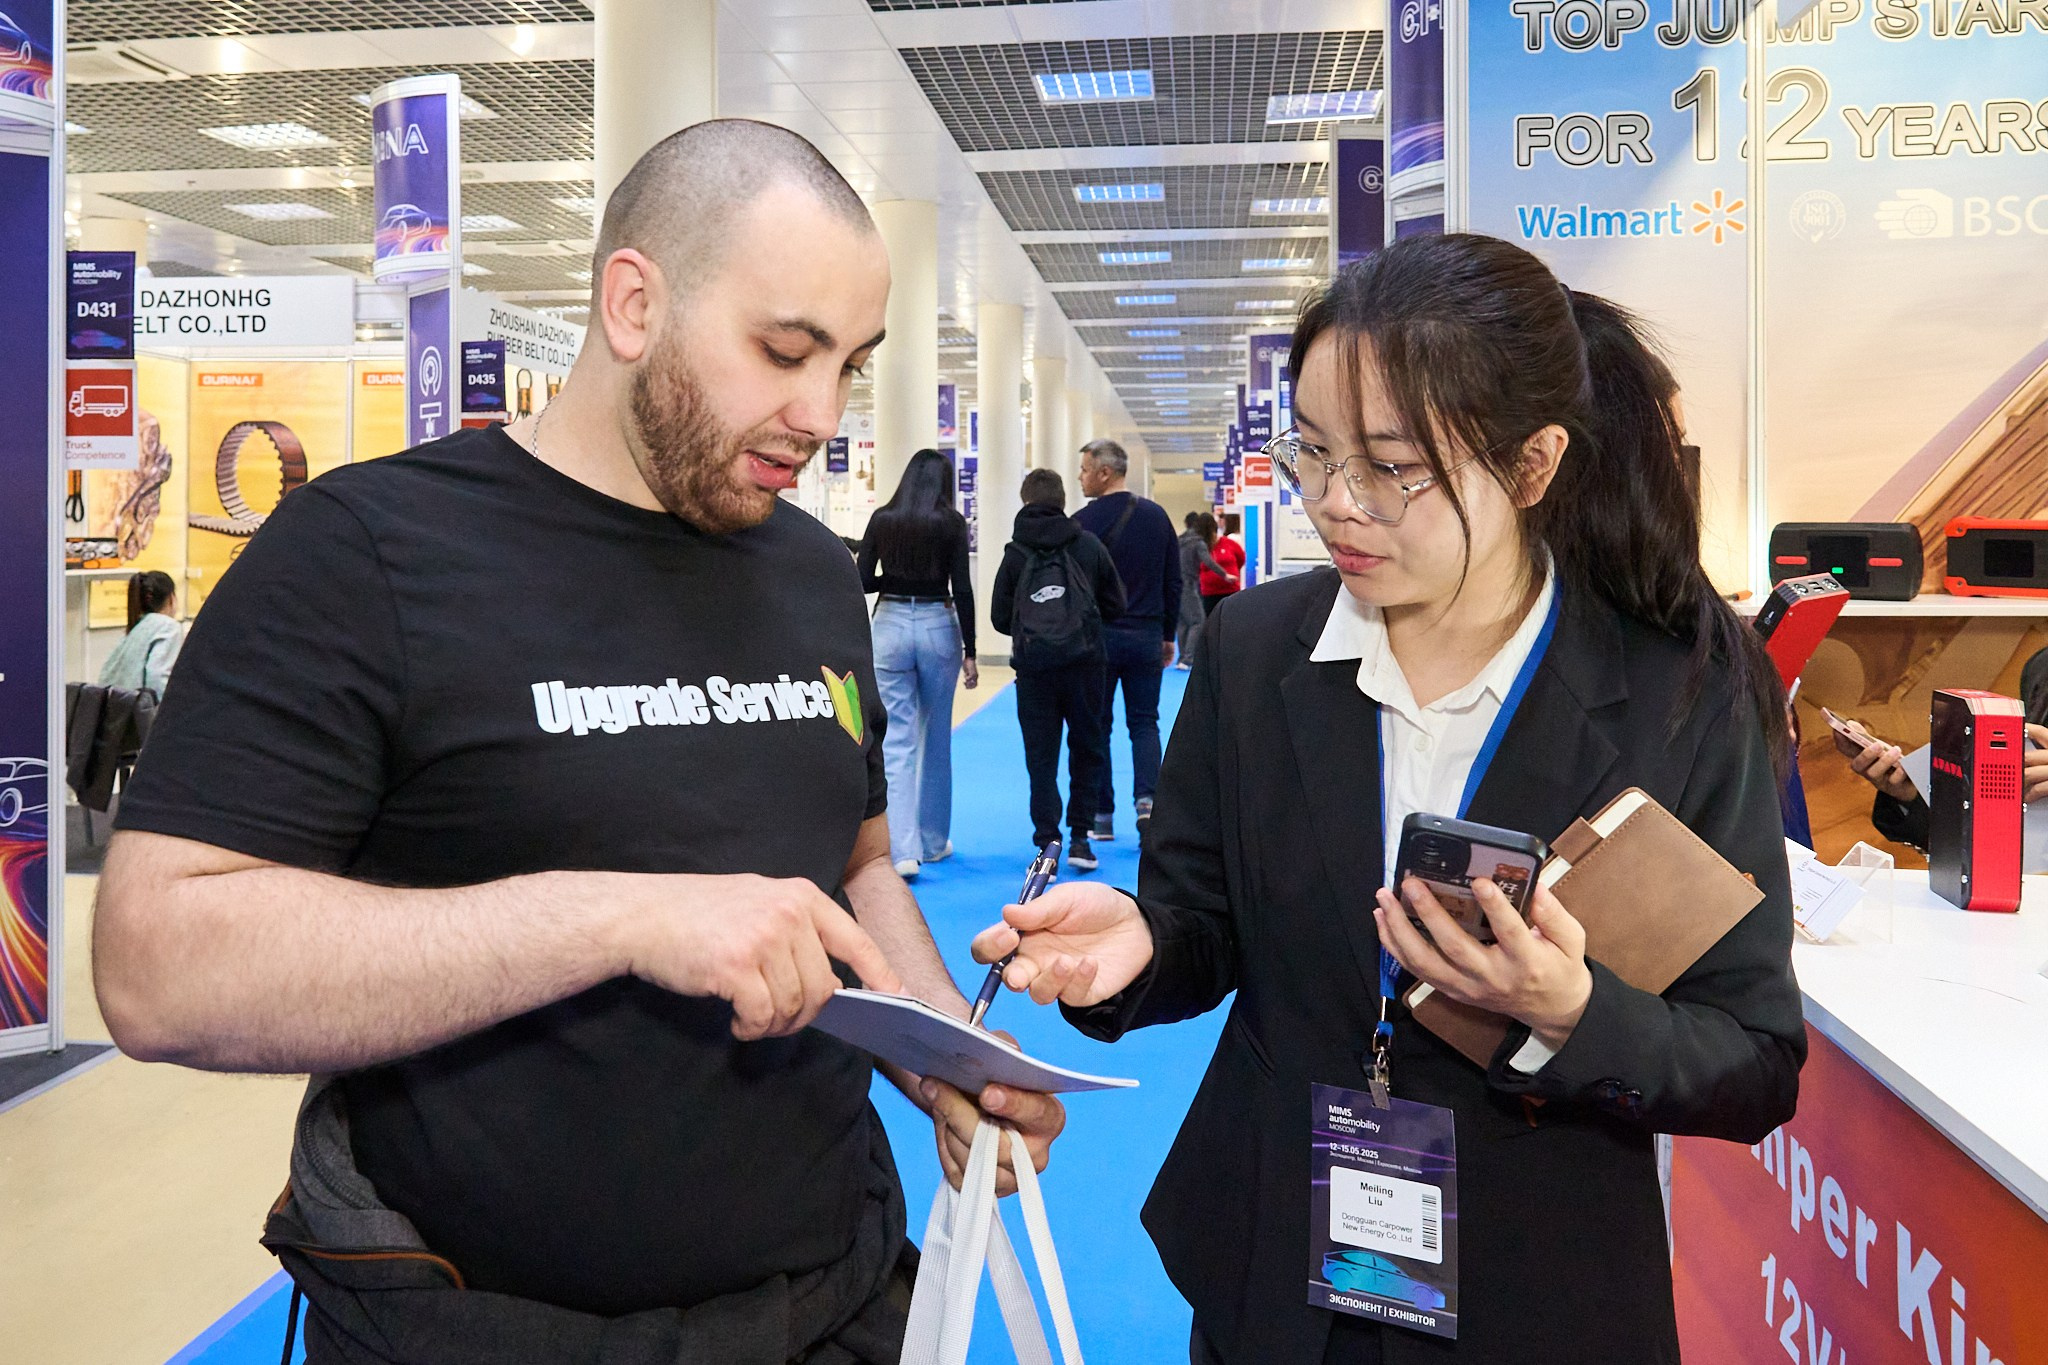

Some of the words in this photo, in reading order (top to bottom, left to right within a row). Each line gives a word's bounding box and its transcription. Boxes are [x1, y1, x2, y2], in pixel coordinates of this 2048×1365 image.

[1513, 0, 1646, 50] TOP
[1516, 114, 1653, 167] FOR
[1675, 69, 1829, 161] 12
[1517, 202, 1683, 239] Walmart
[72, 262, 97, 271] MIMS
[72, 269, 123, 281] automobility
[141, 289, 272, 308] DAZHONHG
[77, 301, 118, 319] D431
[178, 314, 267, 337] CO.,LTD
[489, 307, 537, 337] ZHOUSHAN
[538, 322, 576, 348] DAZHONG
[486, 331, 524, 357] RBER
[524, 340, 546, 361] BELT
[468, 373, 497, 386] D435
[65, 441, 92, 449] Truck
[65, 450, 127, 462] Competence
[531, 677, 712, 736] Upgrade
[705, 673, 835, 725] Service
[1328, 1104, 1353, 1118] MIMS
[1328, 1114, 1381, 1134] automobility
[1328, 1123, 1357, 1134] MOSCOW
[1360, 1181, 1394, 1199] Meiling
[1368, 1196, 1383, 1207] Liu
[1341, 1212, 1377, 1226] Dongguan
[1379, 1219, 1414, 1235] Carpower
[1342, 1222, 1358, 1232] New
[1360, 1225, 1385, 1239] Energy
[1896, 1220, 2006, 1365] Ki
[1329, 1293, 1382, 1314] ЭКСПОНЕНТ
[1388, 1307, 1436, 1327] EXHIBITOR
